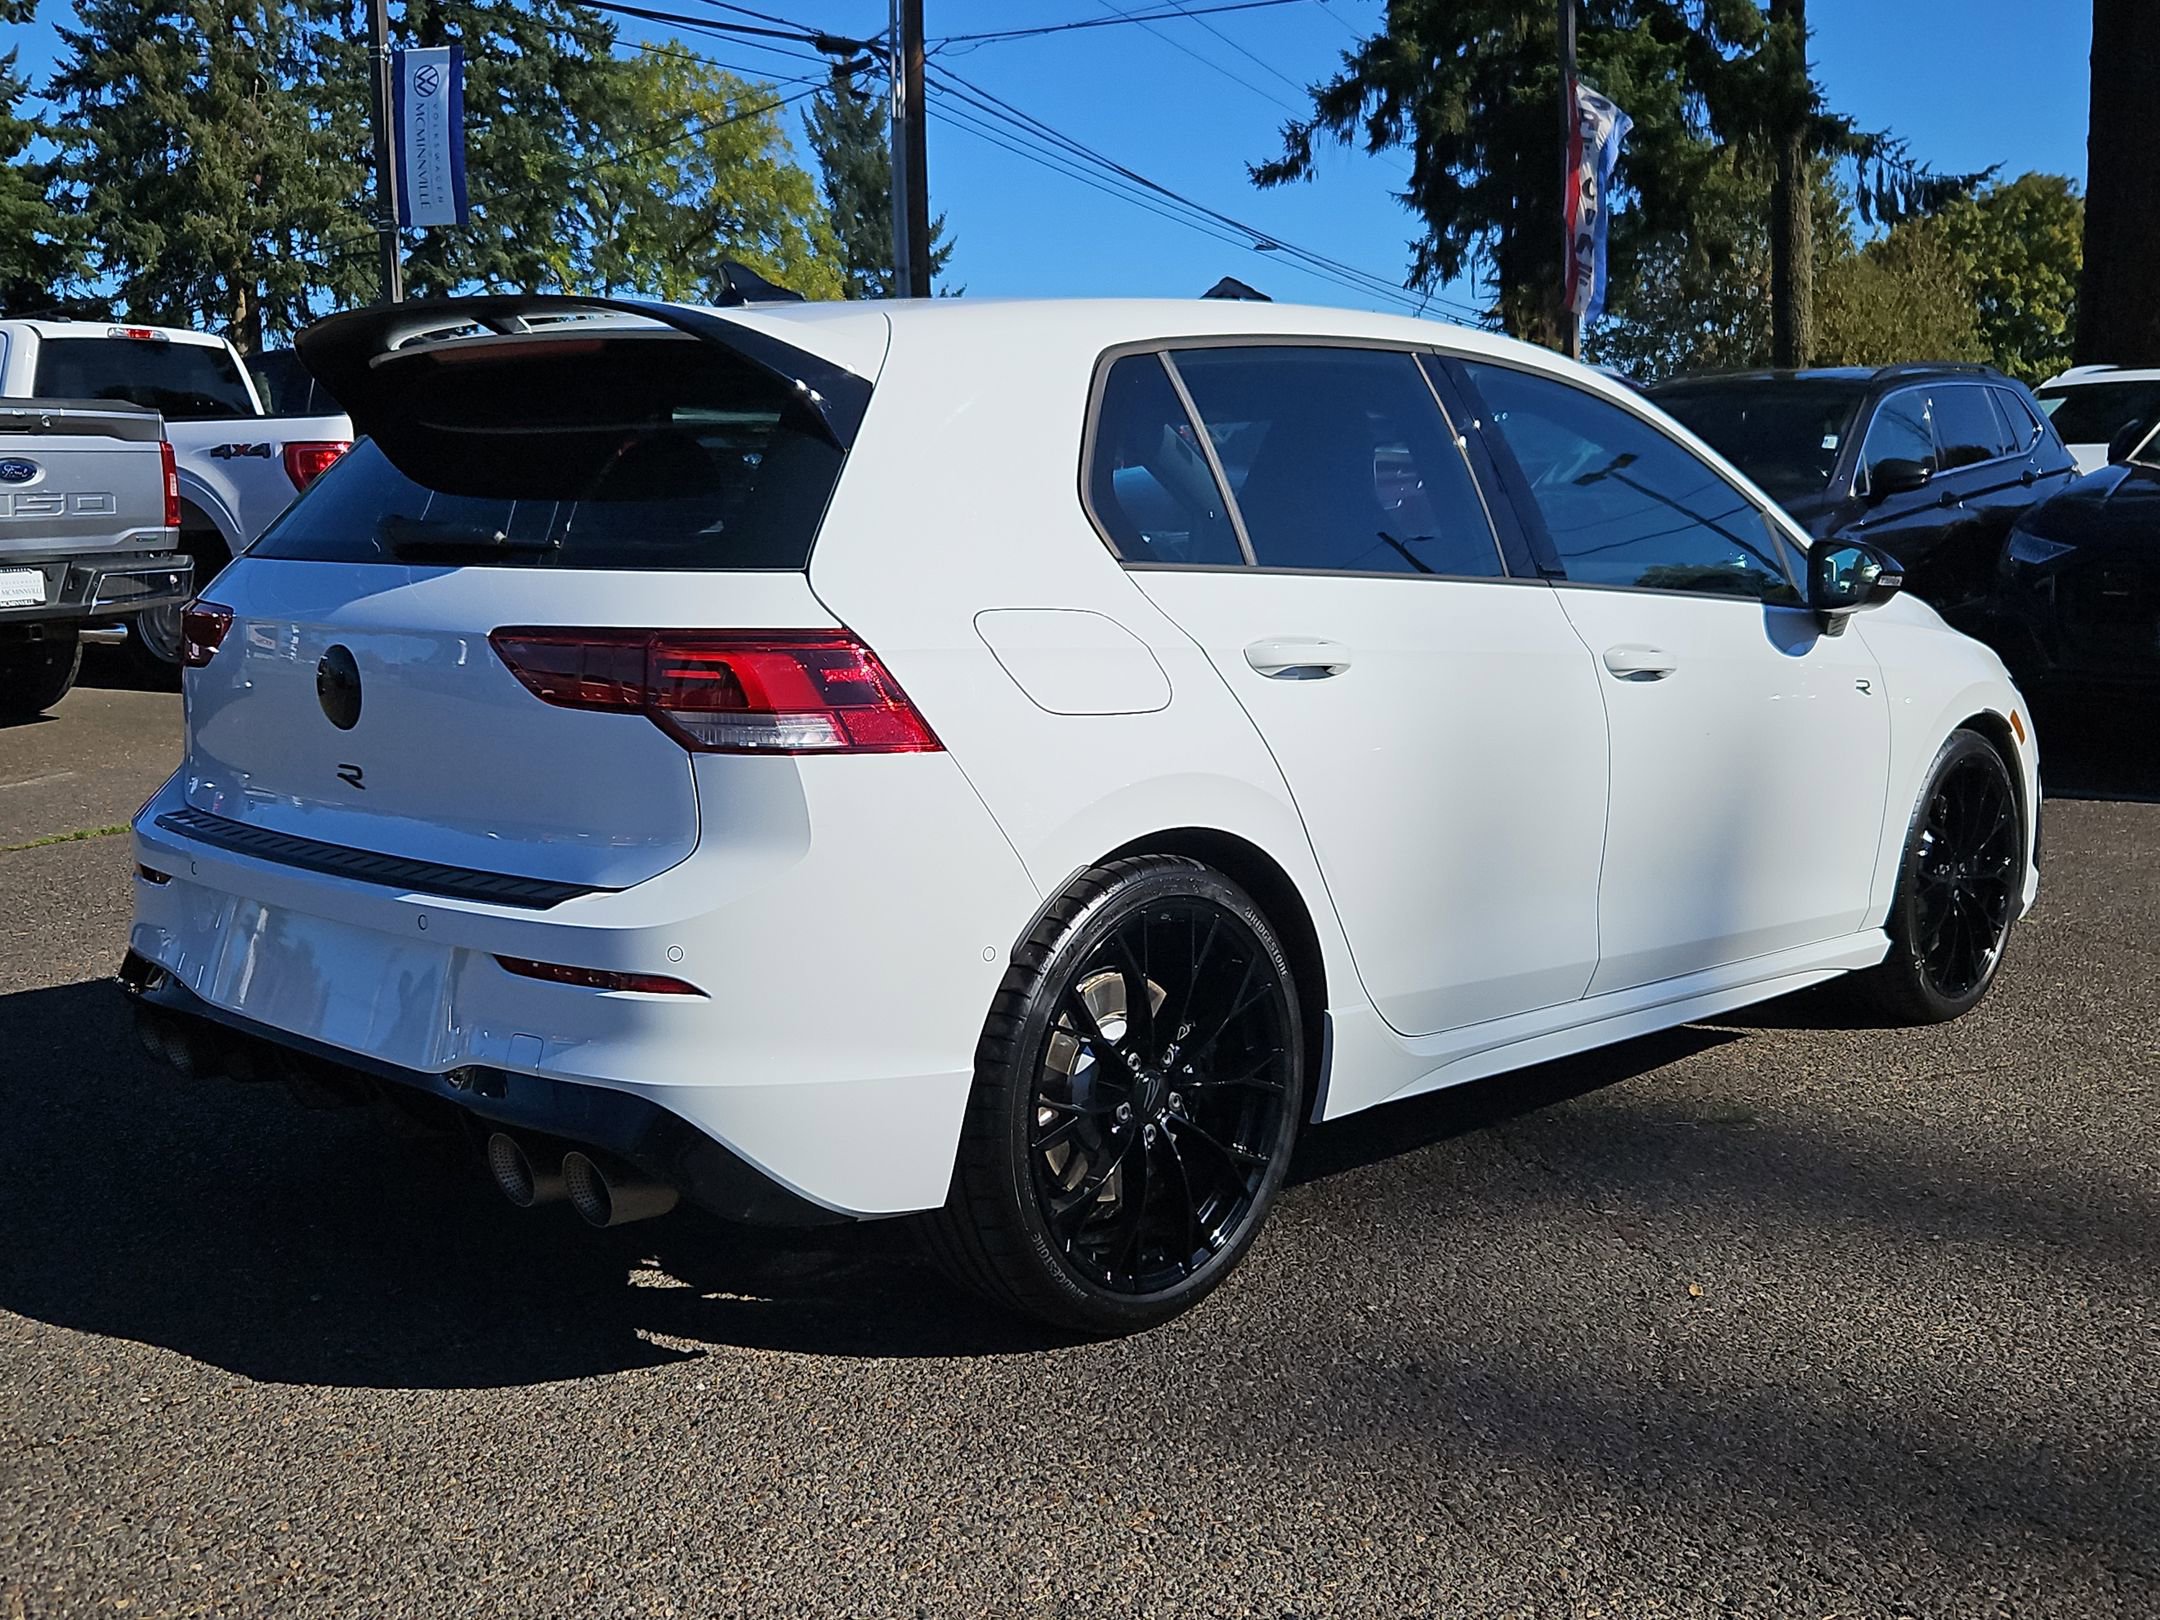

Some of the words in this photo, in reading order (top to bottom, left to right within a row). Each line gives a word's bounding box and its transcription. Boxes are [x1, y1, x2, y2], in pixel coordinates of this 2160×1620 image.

[414, 102, 432, 210] MCMINNVILLE
[431, 103, 444, 204] VOLKSWAGEN
[1855, 679, 1872, 696] R
[337, 763, 367, 791] R
